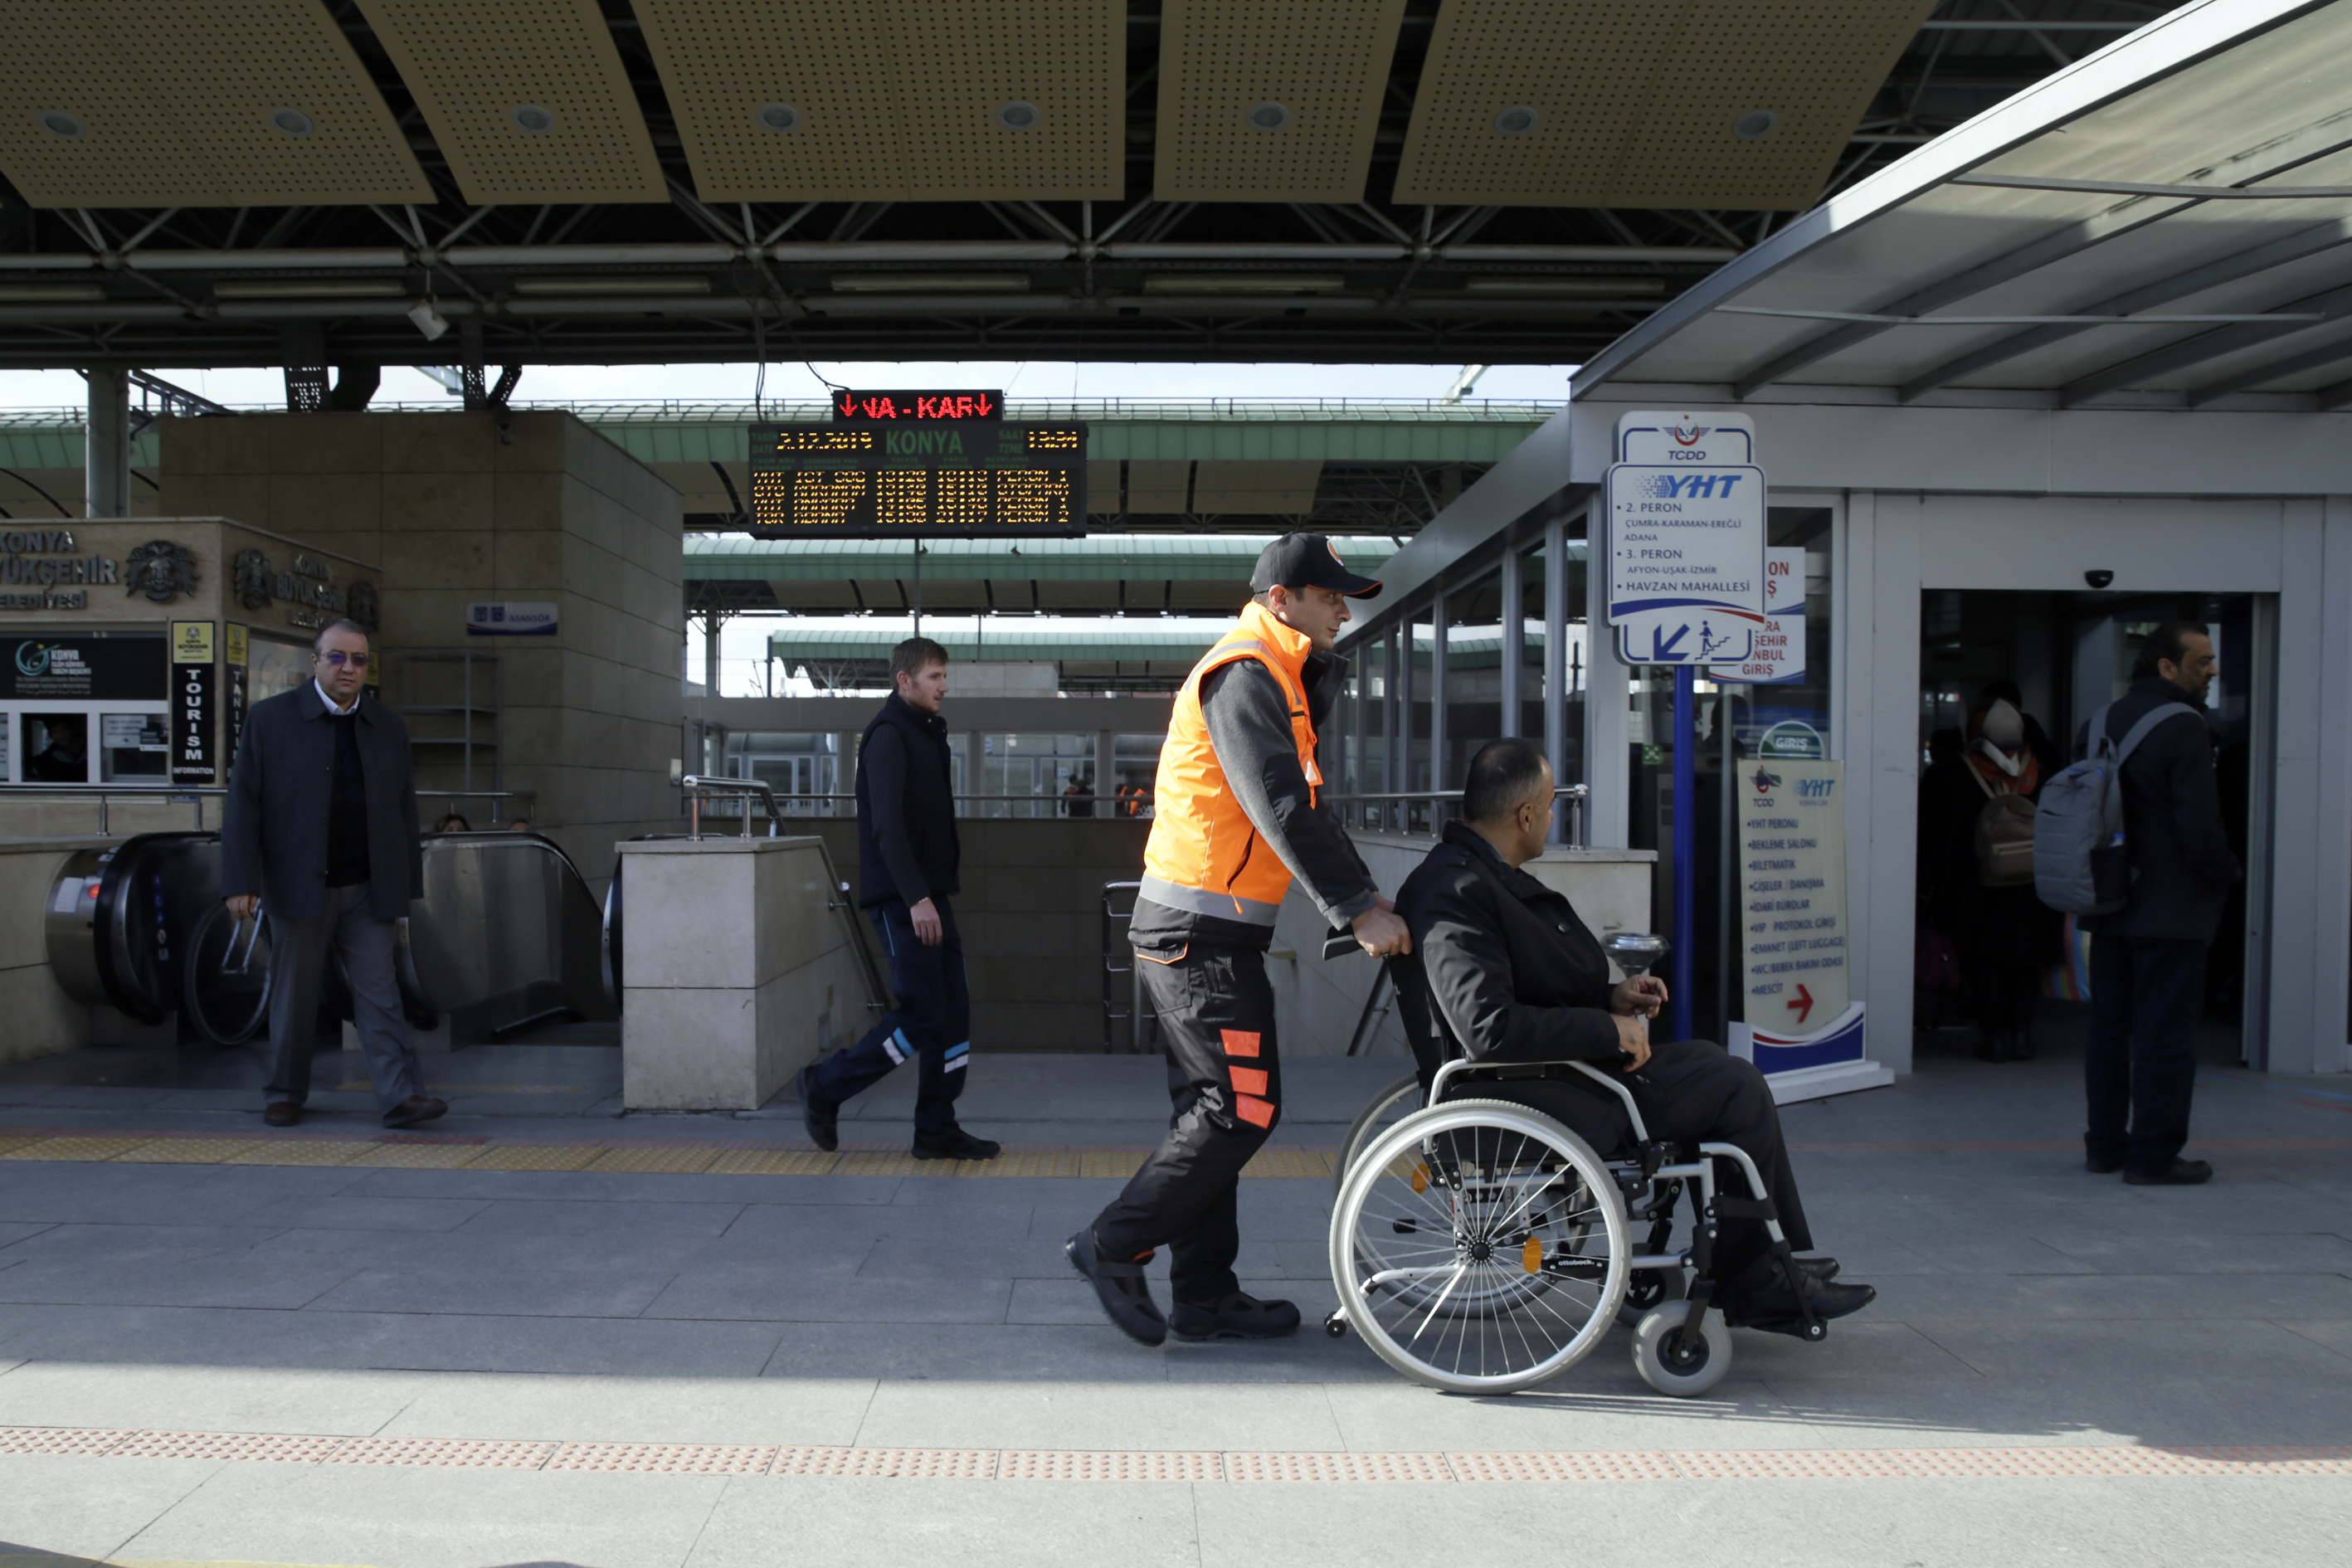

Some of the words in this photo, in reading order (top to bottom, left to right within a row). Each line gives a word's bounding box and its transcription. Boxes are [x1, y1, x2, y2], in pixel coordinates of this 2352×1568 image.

[885, 430, 964, 455] KONYA
[998, 430, 1025, 441] SAAT
[998, 443, 1025, 454] TIME
[1668, 450, 1707, 460] TCDD
[1666, 475, 1742, 498] YHT
[1626, 503, 1636, 513] 2.
[1640, 503, 1682, 513] PERON
[1625, 519, 1741, 528] ÇUMRA-KARAMAN-EREĞLİ
[0, 531, 76, 553] KONYA
[1624, 533, 1658, 542] ADANA
[1626, 549, 1636, 559] 3.
[1641, 549, 1682, 559] PERON
[0, 554, 117, 590] ÜKŞEHİR
[295, 554, 331, 580] KONYA
[1627, 565, 1717, 576] AFYON-UŞAK-İZMİR
[277, 572, 347, 614] BÜYÜKŞEHİR
[1626, 582, 1678, 592] HAVZAN
[1682, 580, 1751, 592] MAHALLESİ
[509, 613, 550, 622] ASANSÖR
[51, 649, 80, 660] KONYA
[1742, 664, 1775, 678] GİRİŞ
[185, 669, 203, 761] TOURISM
[1775, 736, 1809, 752] GİRİŞ
[173, 767, 215, 775] INFORMATION
[1802, 779, 1835, 797] YHT
[1753, 798, 1775, 807] TCDD
[1751, 819, 1766, 829] YHT
[1768, 818, 1799, 829] PERONU
[1752, 839, 1785, 850] BEKLEME
[1787, 838, 1818, 849] SALONU
[1753, 879, 1783, 894] GİŞELER
[1790, 878, 1825, 891] DANIŞMA
[1753, 900, 1775, 913] İDARİ
[1775, 899, 1810, 911] BÜROLAR
[1754, 923, 1766, 933] VIP
[1774, 919, 1814, 931] PROTOKOL
[1815, 914, 1836, 928] GİRİŞİ
[1755, 942, 1785, 954] EMANET
[1788, 939, 1808, 952] (LEFT
[1809, 936, 1845, 949] LUGGAGE)
[1795, 959, 1820, 971] BAKIM
[1821, 957, 1843, 968] ODASI
[1755, 981, 1784, 995] MESCİT
